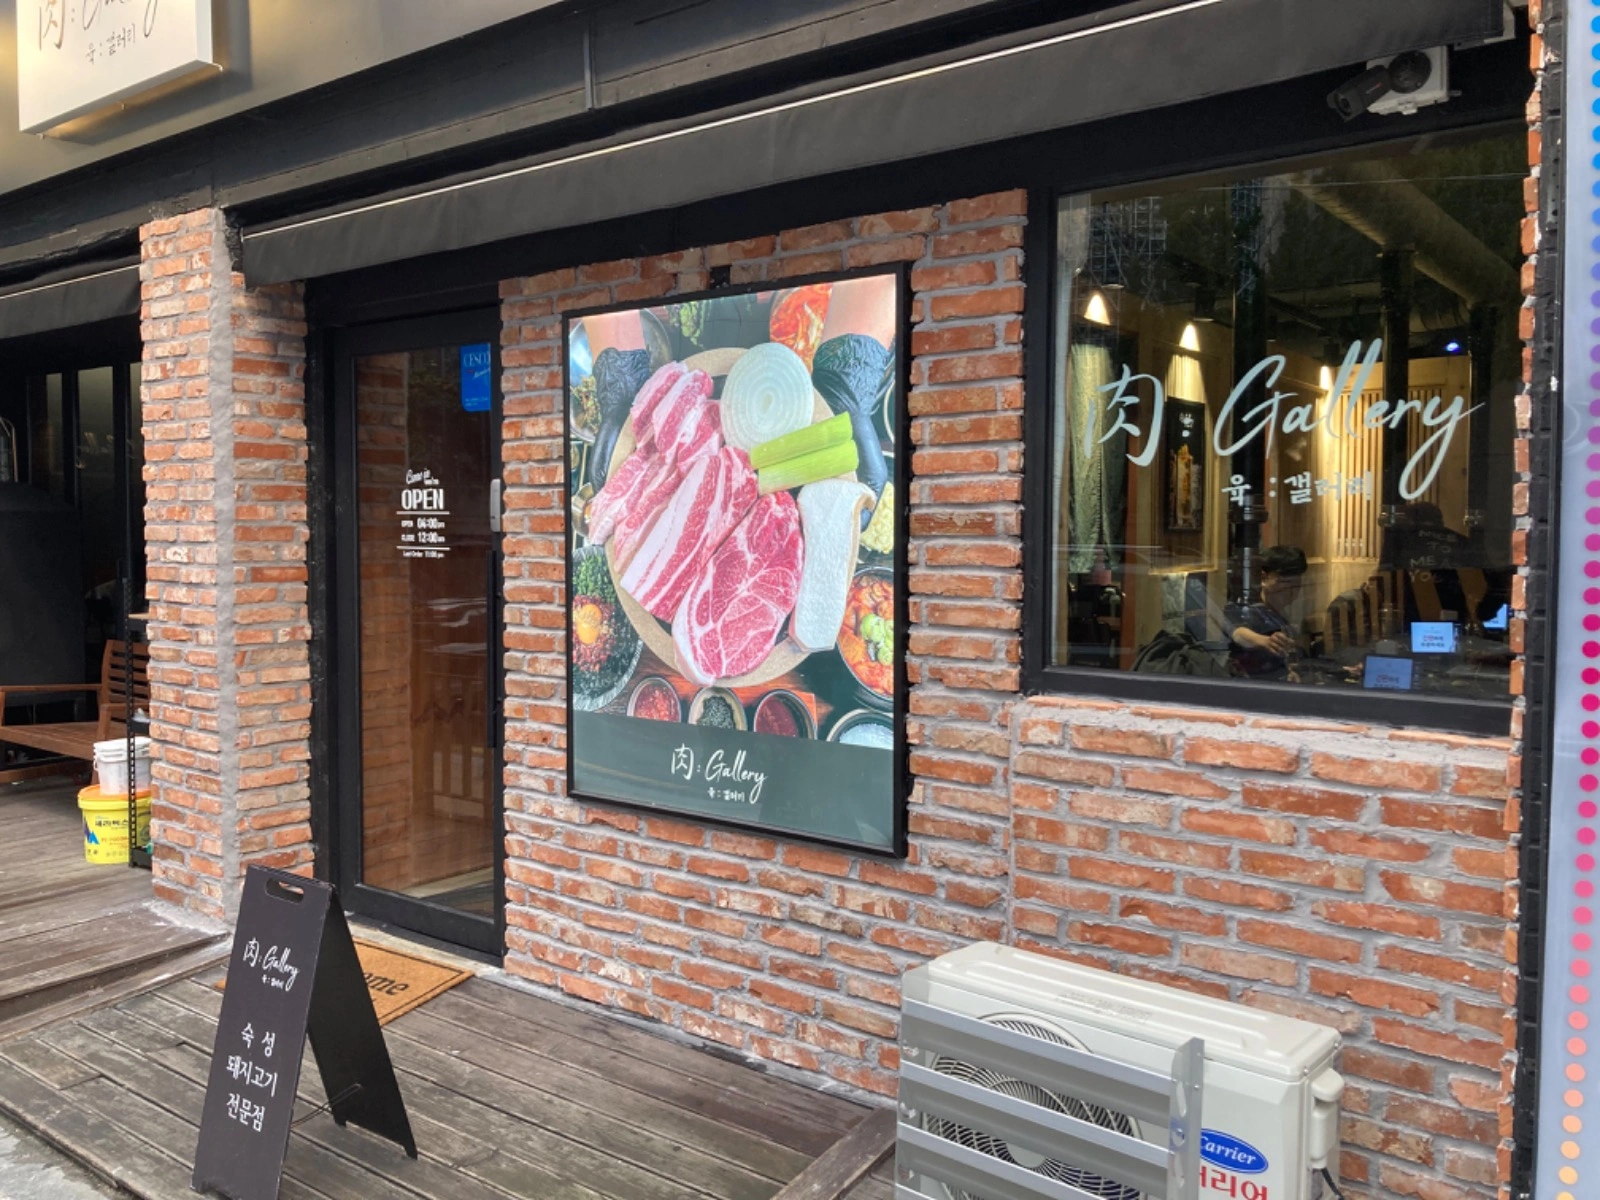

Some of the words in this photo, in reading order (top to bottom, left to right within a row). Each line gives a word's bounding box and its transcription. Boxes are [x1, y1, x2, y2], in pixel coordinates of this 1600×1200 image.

[1213, 338, 1486, 501] Gallery
[401, 488, 445, 511] OPEN
[1222, 475, 1252, 506] 육
[1284, 470, 1372, 505] 갤러리
[705, 749, 768, 804] Gallery
[262, 945, 300, 991] Gallery
[226, 1055, 278, 1098] 돼지고기
[226, 1093, 266, 1133] 전문점
